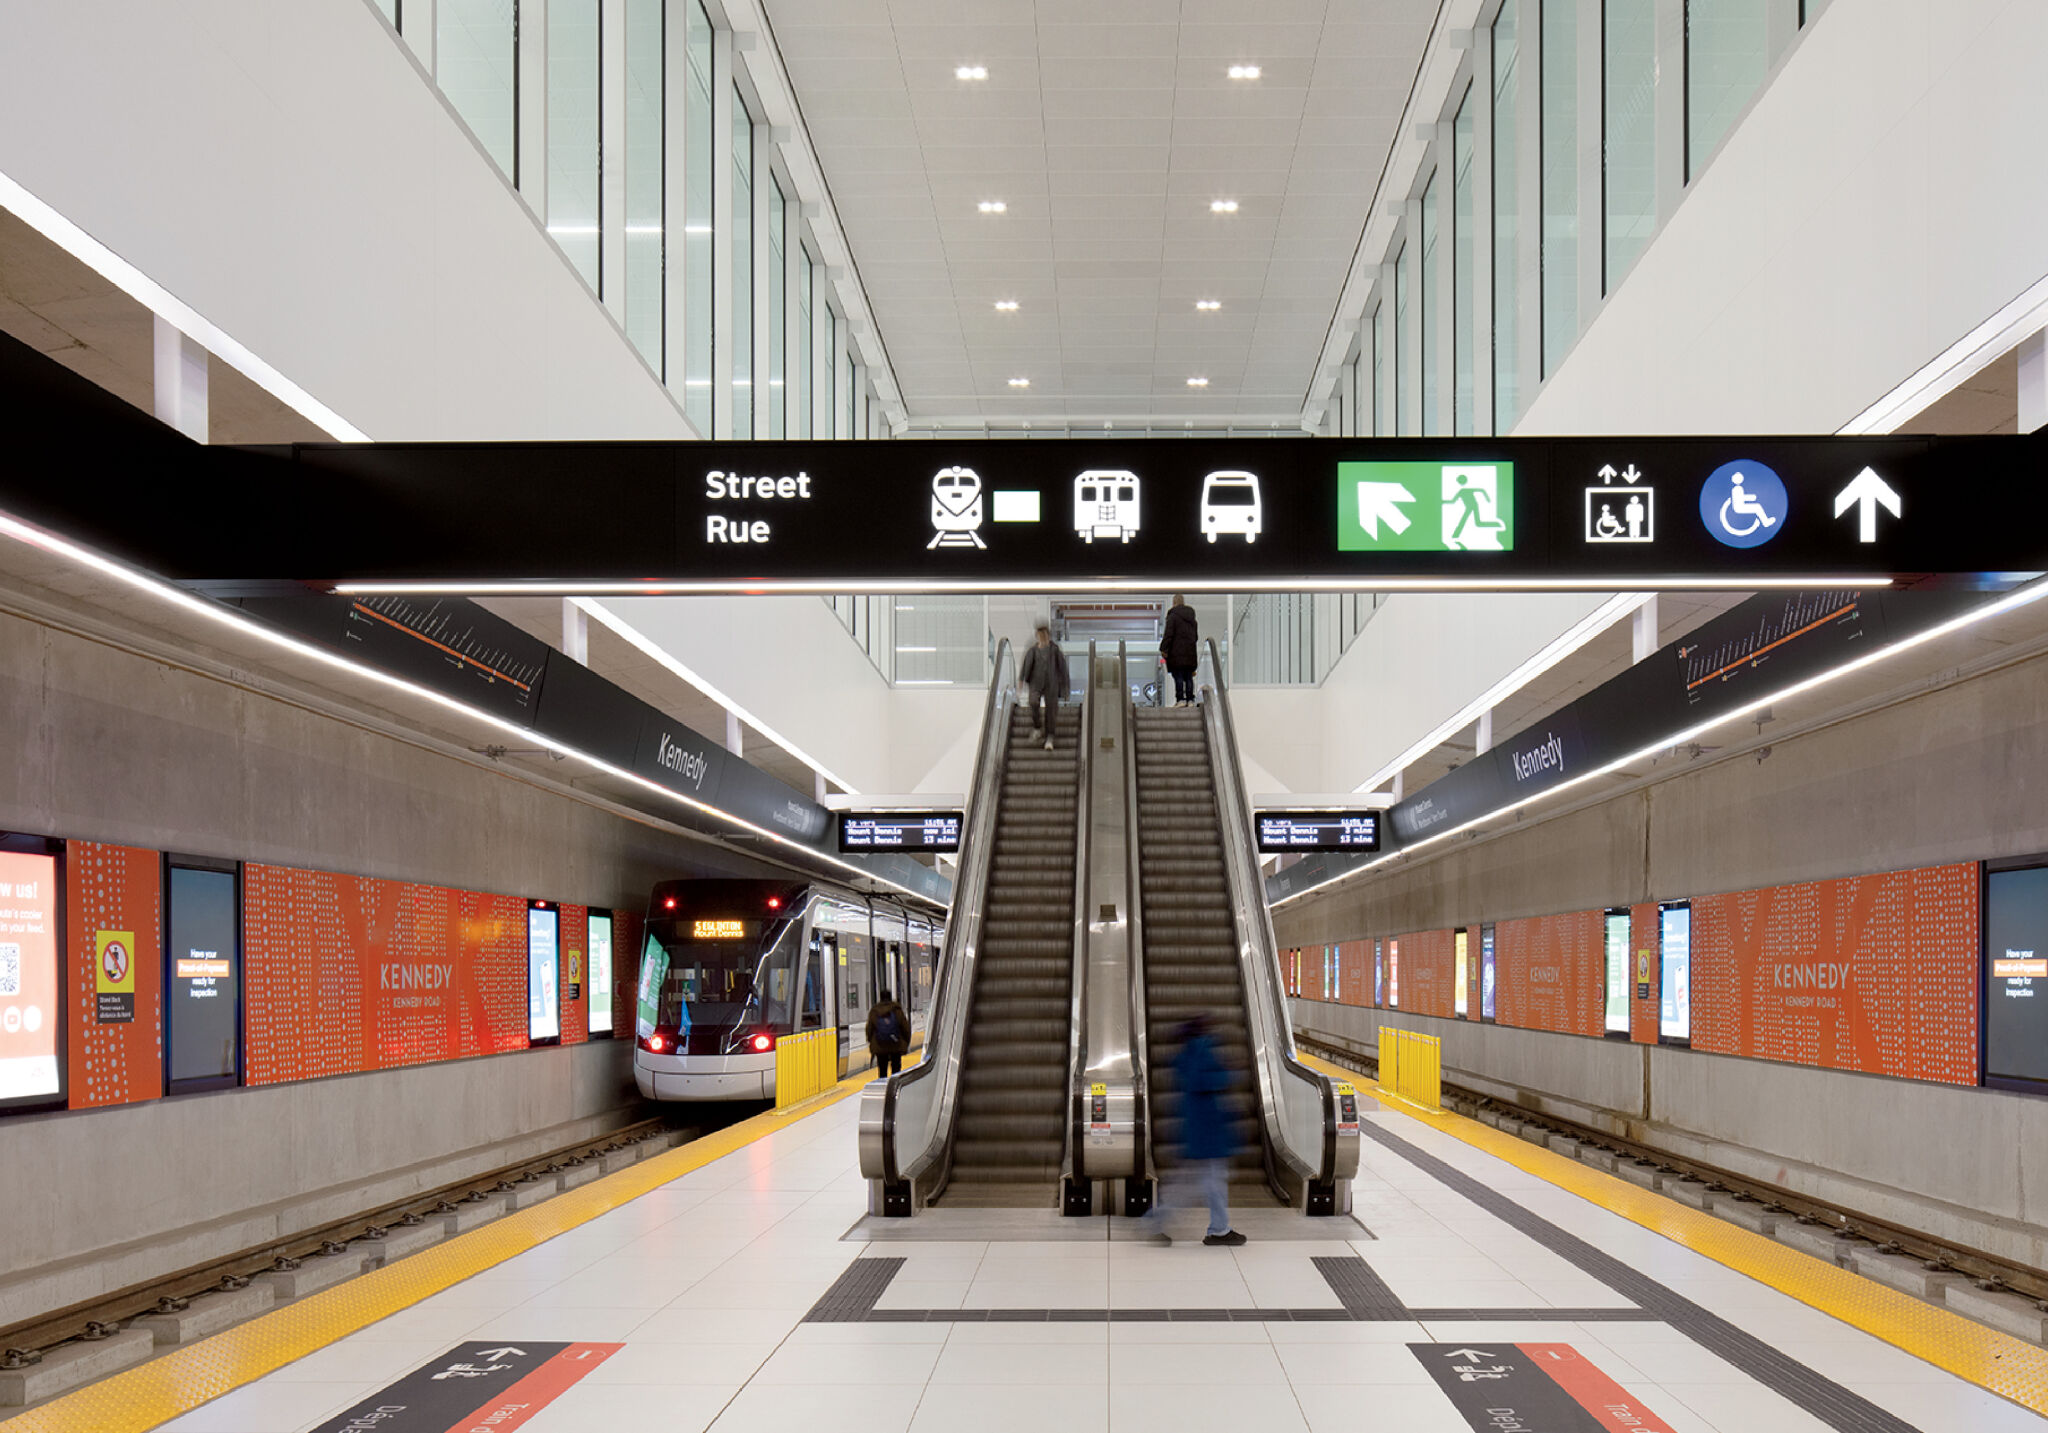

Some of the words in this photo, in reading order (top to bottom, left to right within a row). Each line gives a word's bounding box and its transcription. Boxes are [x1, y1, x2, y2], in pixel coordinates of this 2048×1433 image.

[705, 470, 811, 499] Street
[706, 514, 771, 543] Rue
[657, 732, 707, 791] Kennedy
[1512, 732, 1564, 782] Kennedy
[874, 827, 902, 835] Dennis
[1263, 827, 1287, 835] Mount
[1290, 827, 1318, 835] Dennis
[847, 836, 871, 844] Mount
[874, 836, 902, 844] Dennis
[924, 836, 934, 844] 13
[937, 836, 957, 844] mins
[1263, 836, 1287, 844] Mount
[1290, 836, 1318, 844] Dennis
[1353, 836, 1373, 844] mins
[15, 880, 38, 899] us!
[9, 924, 25, 936] your
[702, 921, 743, 931] EGLINTON
[694, 930, 716, 938] Mount
[717, 930, 744, 938] Dennis
[190, 949, 204, 958] Have
[205, 951, 217, 960] your
[2006, 949, 2020, 958] Have
[2020, 951, 2034, 960] your
[381, 963, 453, 990] KENNEDY
[1774, 962, 1849, 989] KENNEDY
[1785, 996, 1814, 1008] KENNEDY
[1816, 996, 1837, 1009] ROAD
[480, 1403, 530, 1425] Train
[1602, 1402, 1643, 1426] Train
